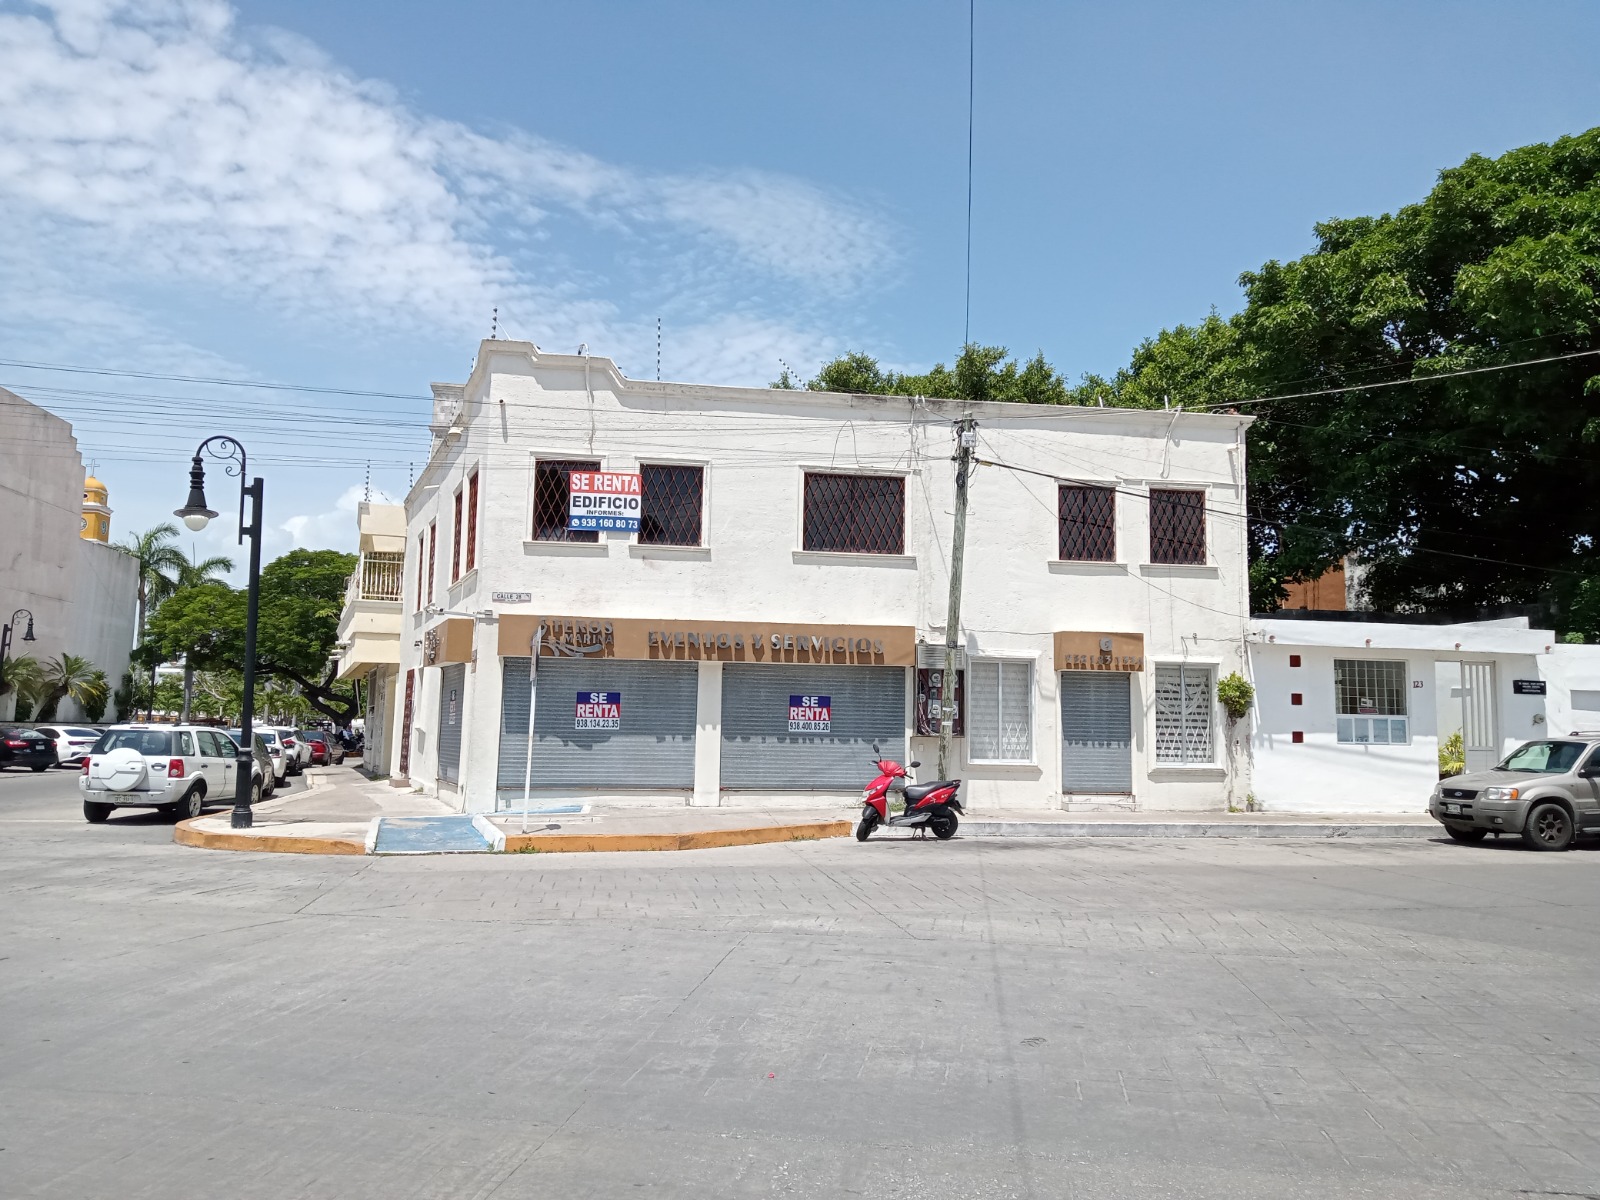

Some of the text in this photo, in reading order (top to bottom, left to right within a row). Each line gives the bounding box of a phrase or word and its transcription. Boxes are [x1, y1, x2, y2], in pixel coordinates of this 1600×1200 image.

[572, 474, 639, 492] SE RENTA
[573, 496, 639, 510] EDIFICIO
[582, 518, 638, 528] 938 160 80 73
[564, 633, 614, 644] MARINA
[648, 631, 885, 654] EVENTOS Y SERVICIOS
[590, 692, 608, 704] SE
[802, 696, 818, 706] SE
[577, 704, 618, 718] RENTA
[790, 707, 829, 720] RENTA
